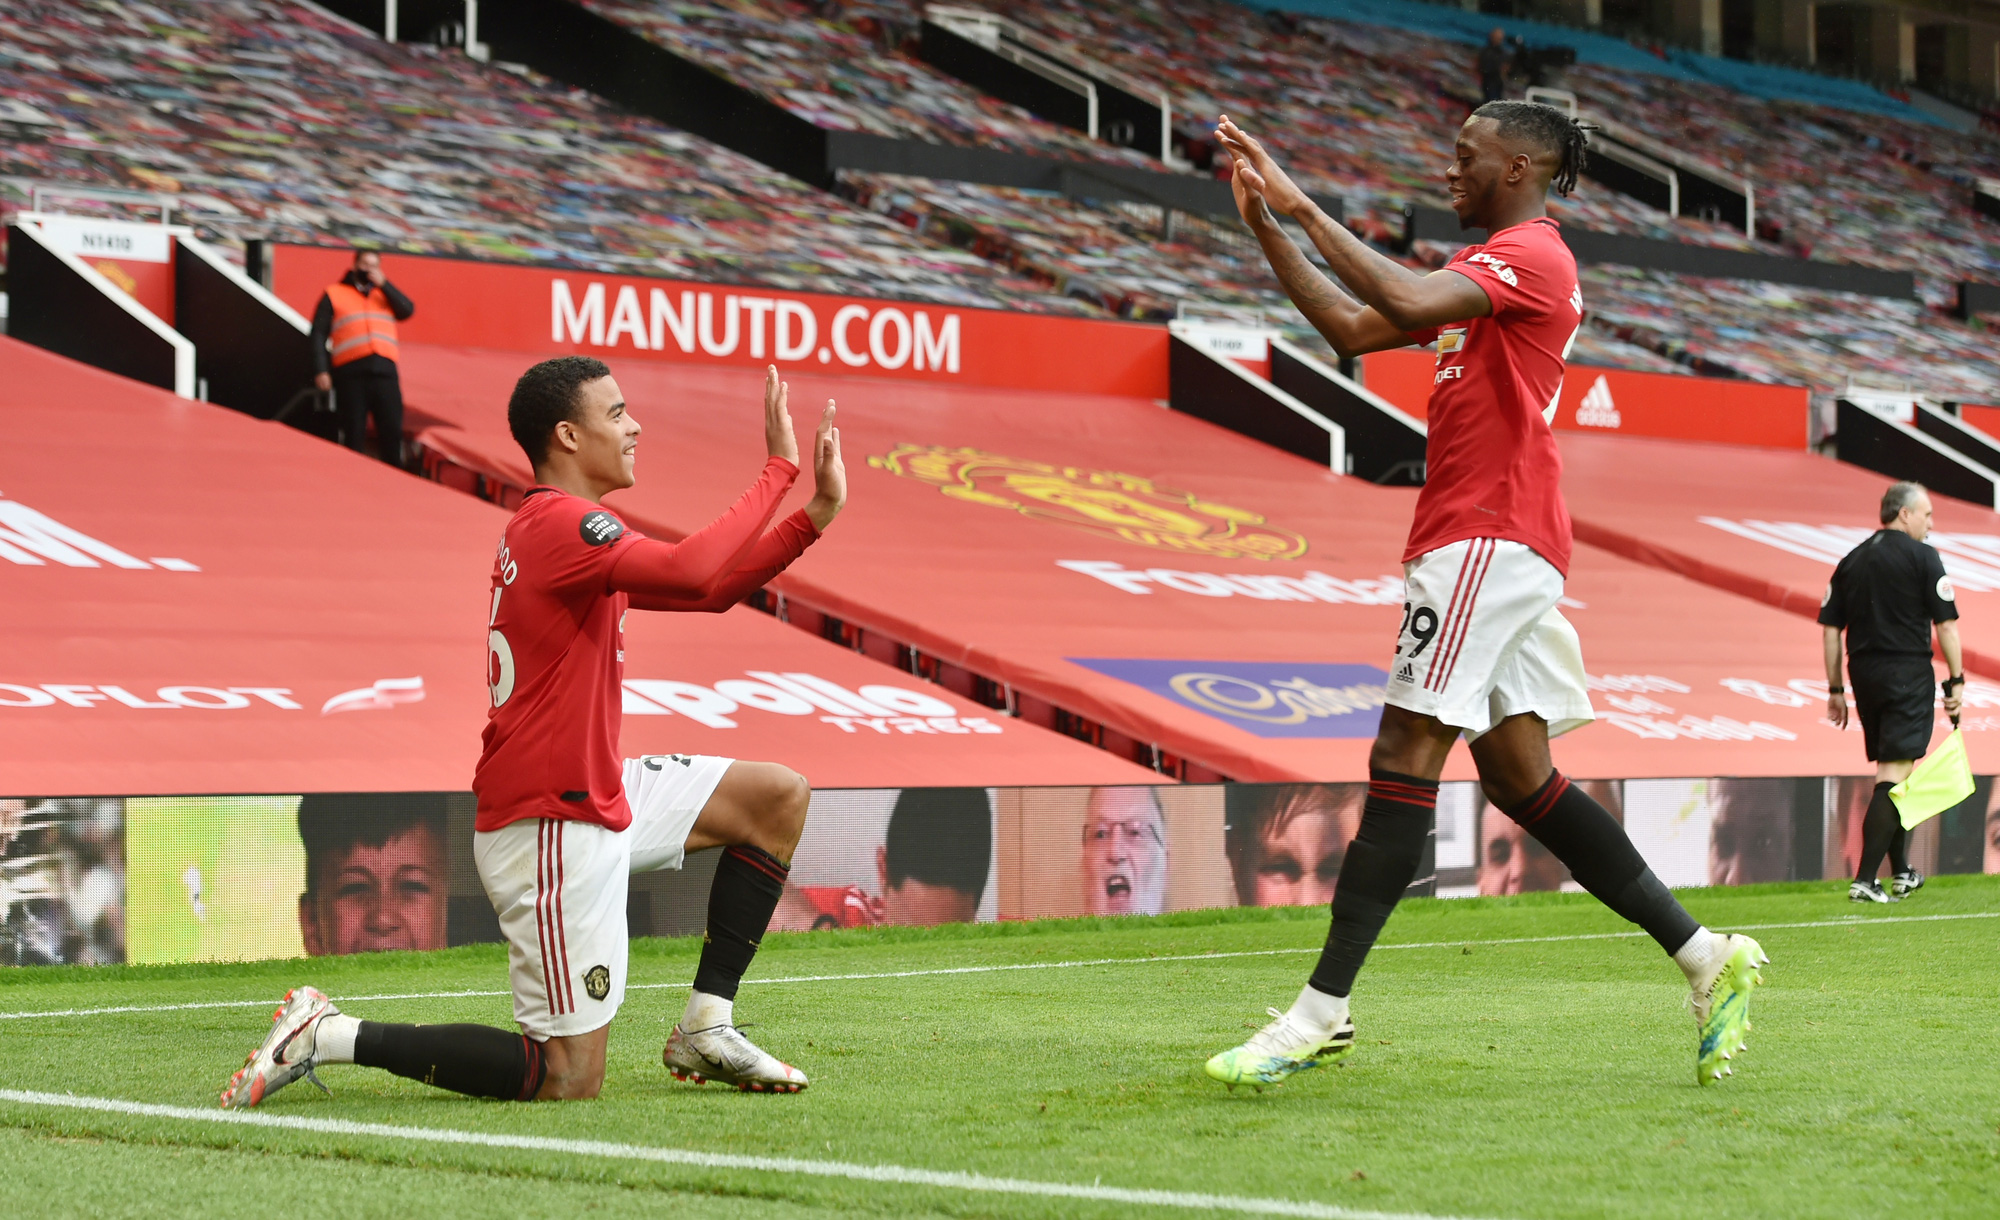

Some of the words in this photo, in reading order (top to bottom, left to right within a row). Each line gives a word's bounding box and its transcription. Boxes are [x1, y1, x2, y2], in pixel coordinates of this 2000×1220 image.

[551, 278, 961, 374] MANUTD.COM
[1575, 407, 1621, 429] adidas
[585, 514, 605, 530] BLACK
[592, 519, 610, 534] LIVES
[596, 523, 619, 541] MATTER
[818, 715, 1003, 735] TYRES
